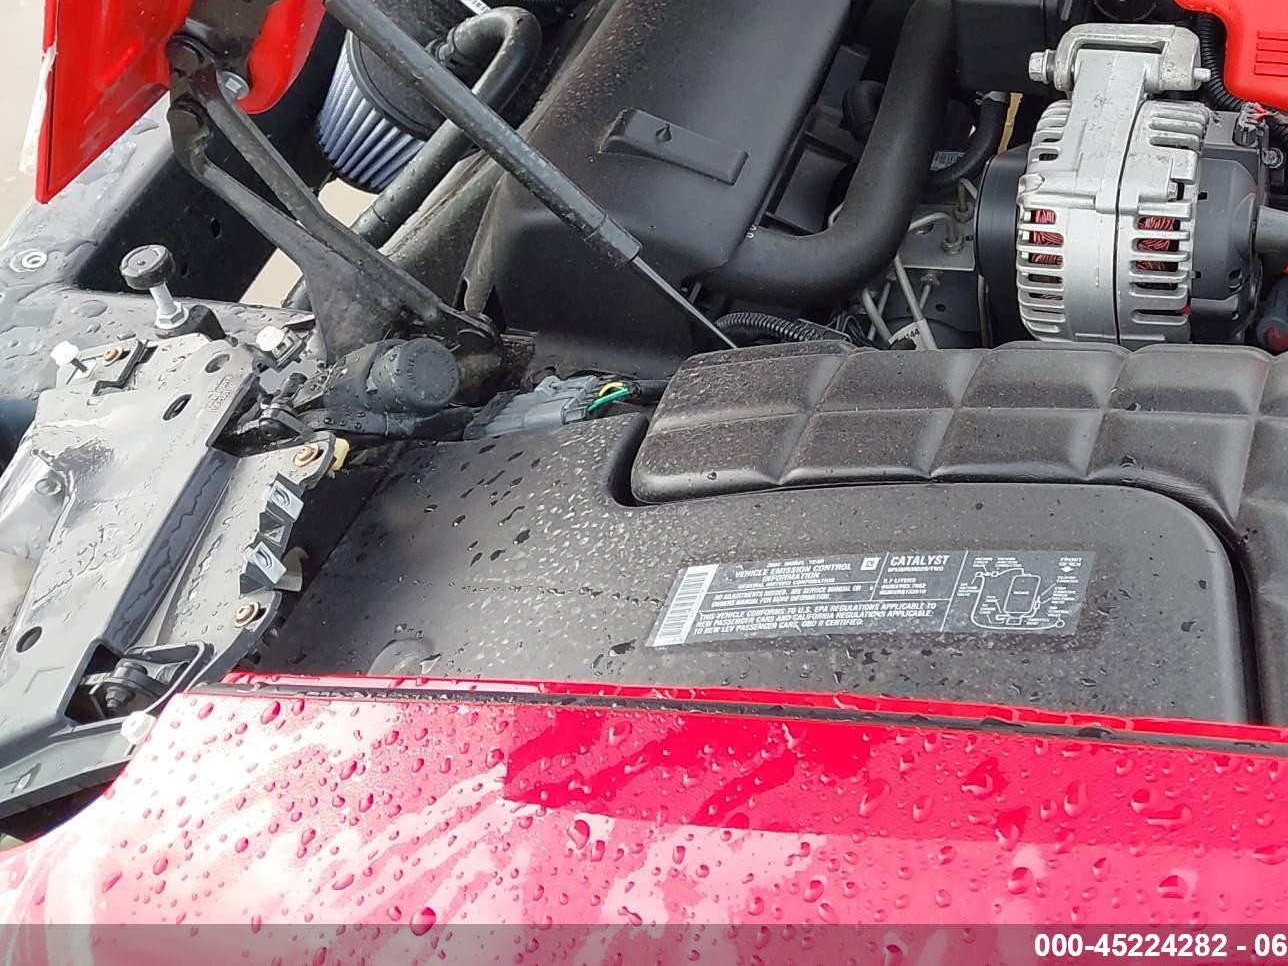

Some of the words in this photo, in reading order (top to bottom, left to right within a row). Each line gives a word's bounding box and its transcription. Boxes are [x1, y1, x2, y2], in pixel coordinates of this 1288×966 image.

[889, 555, 951, 567] CATALYST
[735, 568, 769, 579] VEHICLE
[770, 565, 811, 575] EMISSION
[812, 563, 852, 572] CONTROL
[761, 572, 821, 582] INFORMATION
[700, 613, 715, 621] THIS
[715, 611, 745, 620] VEHICLE
[746, 608, 786, 617] CONFORMS
[797, 606, 812, 614] U.S.
[814, 605, 828, 613] EPA
[829, 603, 879, 612] REGULATIONS
[880, 602, 924, 611] APPLICABLE
[695, 619, 714, 628] NEW
[713, 617, 755, 626] PASSENGER
[755, 615, 775, 623] CARS
[775, 614, 792, 622] AND
[792, 612, 835, 621] CALIFORNIA
[835, 610, 886, 619] REGULATIONS
[703, 626, 721, 634] NEW
[721, 625, 736, 633] LEV
[735, 622, 778, 632] PASSENGER
